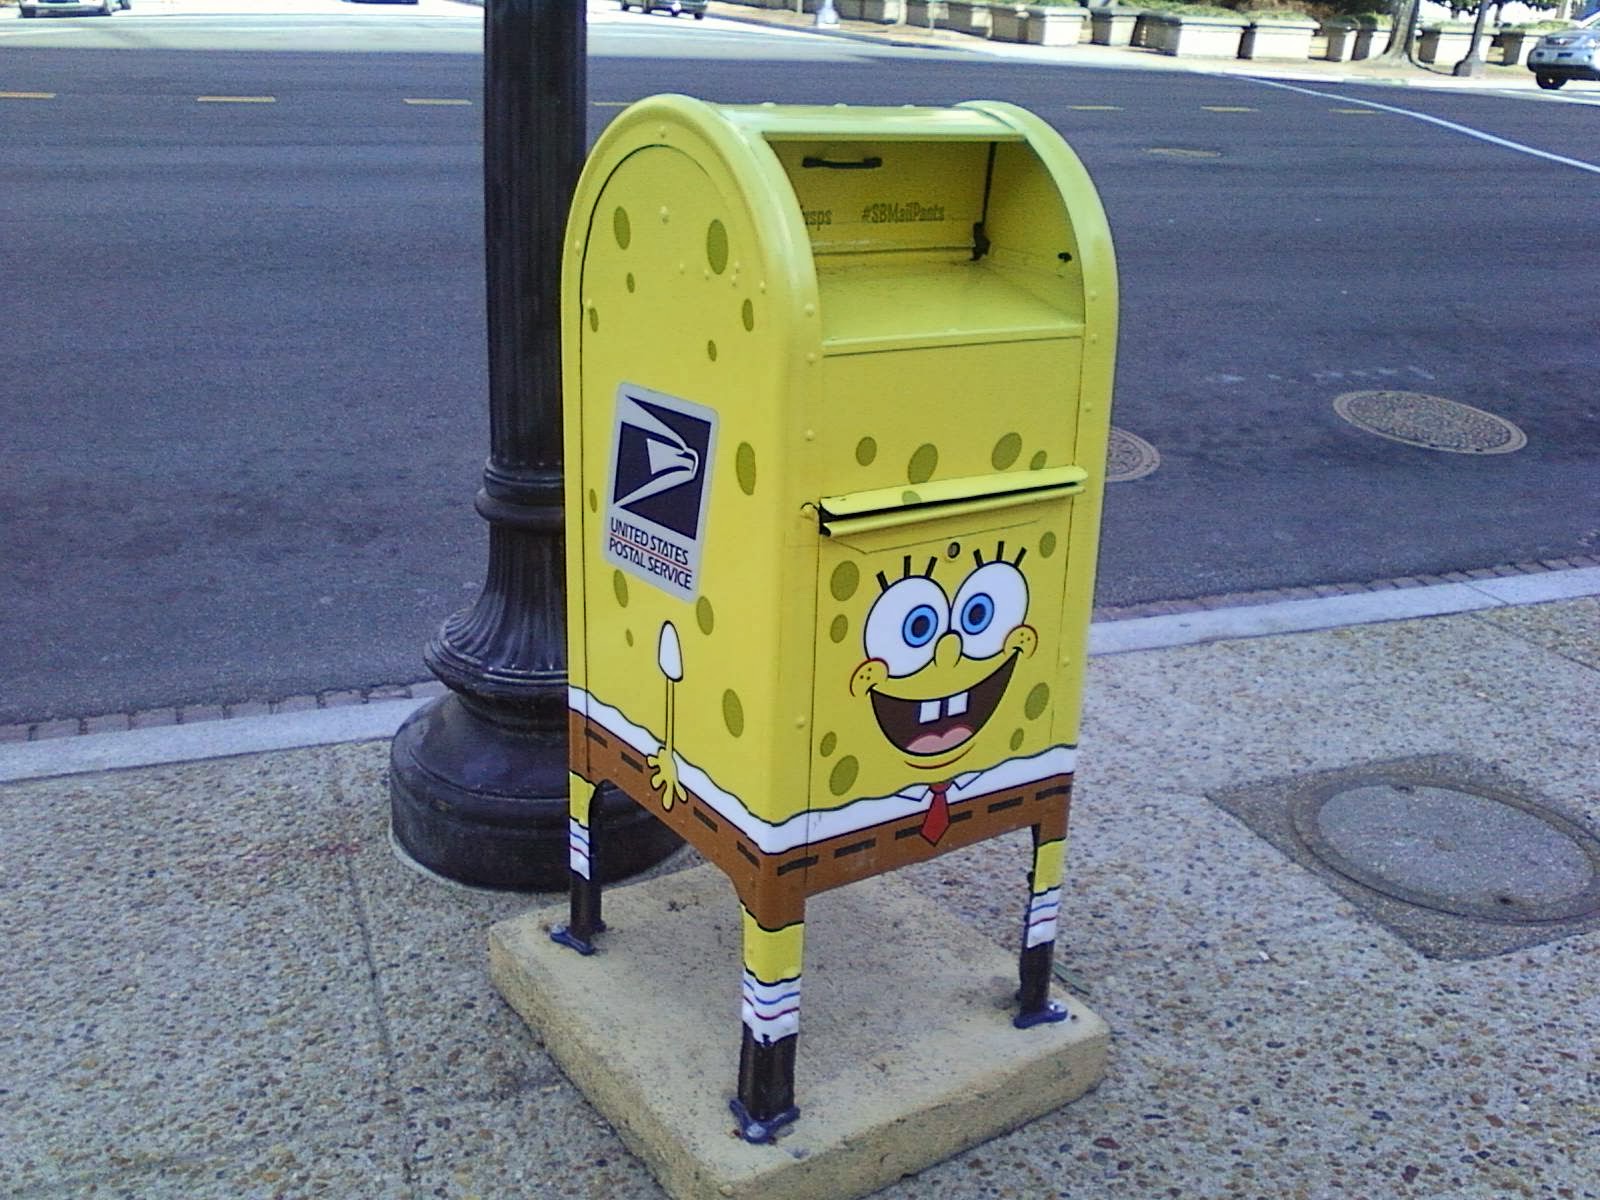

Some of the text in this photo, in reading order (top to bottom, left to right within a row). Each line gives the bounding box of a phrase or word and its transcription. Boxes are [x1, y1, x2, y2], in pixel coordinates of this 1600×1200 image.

[861, 201, 945, 224] #SBMailPants
[609, 537, 692, 590] POSTAL SERVICE
[610, 516, 688, 566] UNITED STATES
